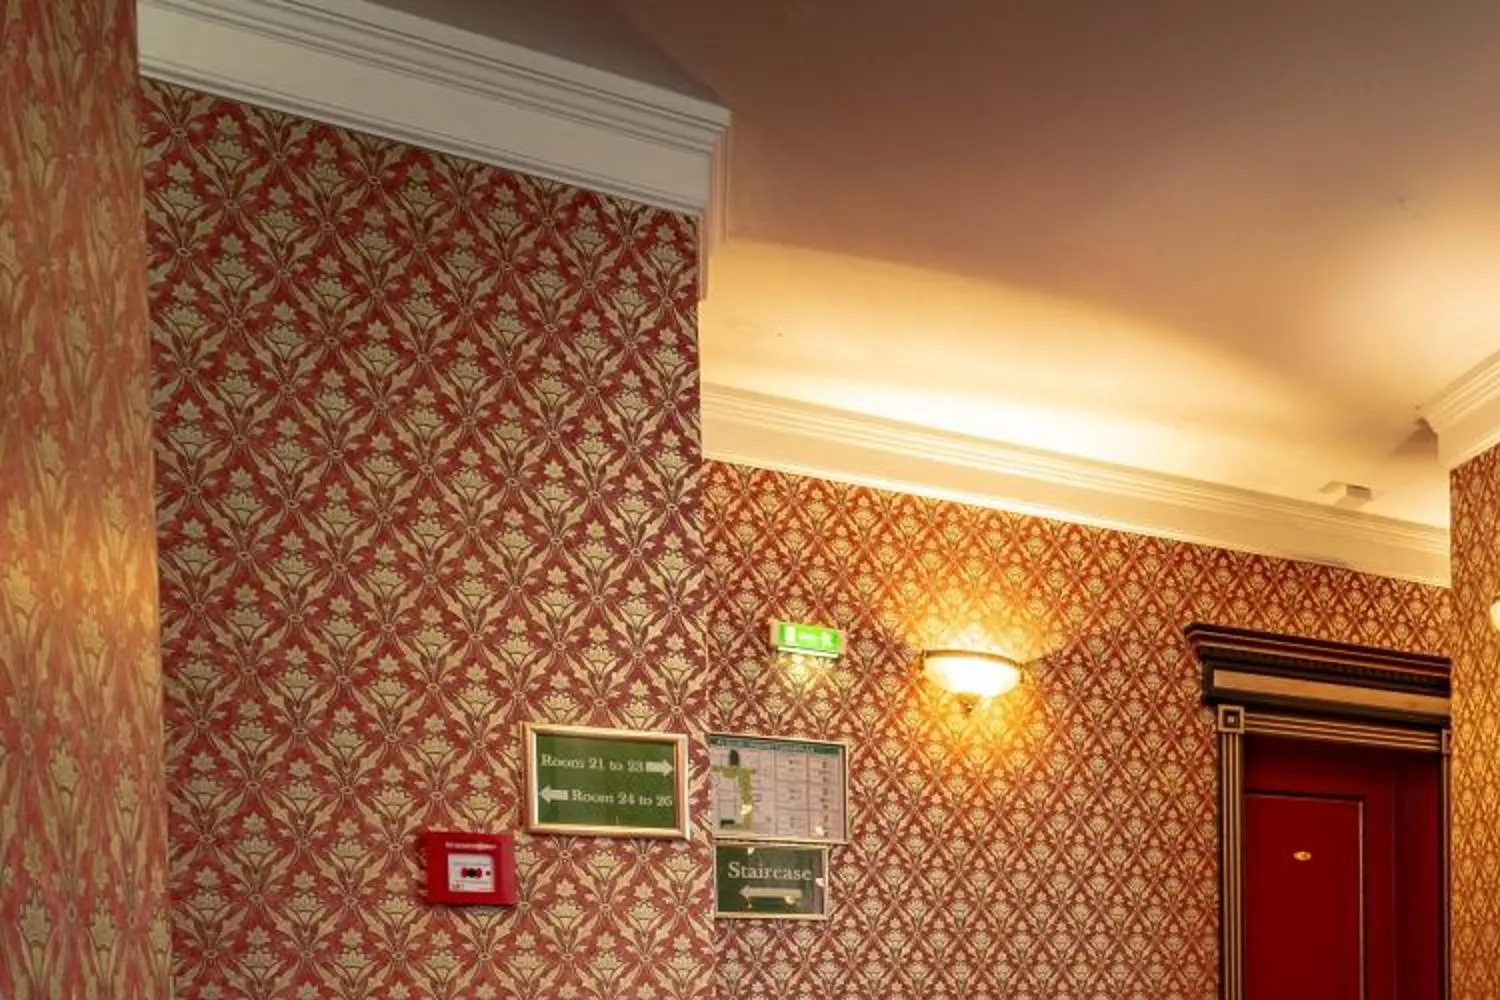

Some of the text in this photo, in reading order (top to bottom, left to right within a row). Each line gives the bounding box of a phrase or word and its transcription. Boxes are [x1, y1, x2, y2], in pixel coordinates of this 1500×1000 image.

[541, 753, 585, 769] Room
[587, 757, 604, 770] 21
[609, 760, 624, 771] to
[571, 789, 615, 803] Room
[617, 792, 635, 805] 24
[639, 795, 653, 806] to
[727, 861, 812, 881] Staircase
